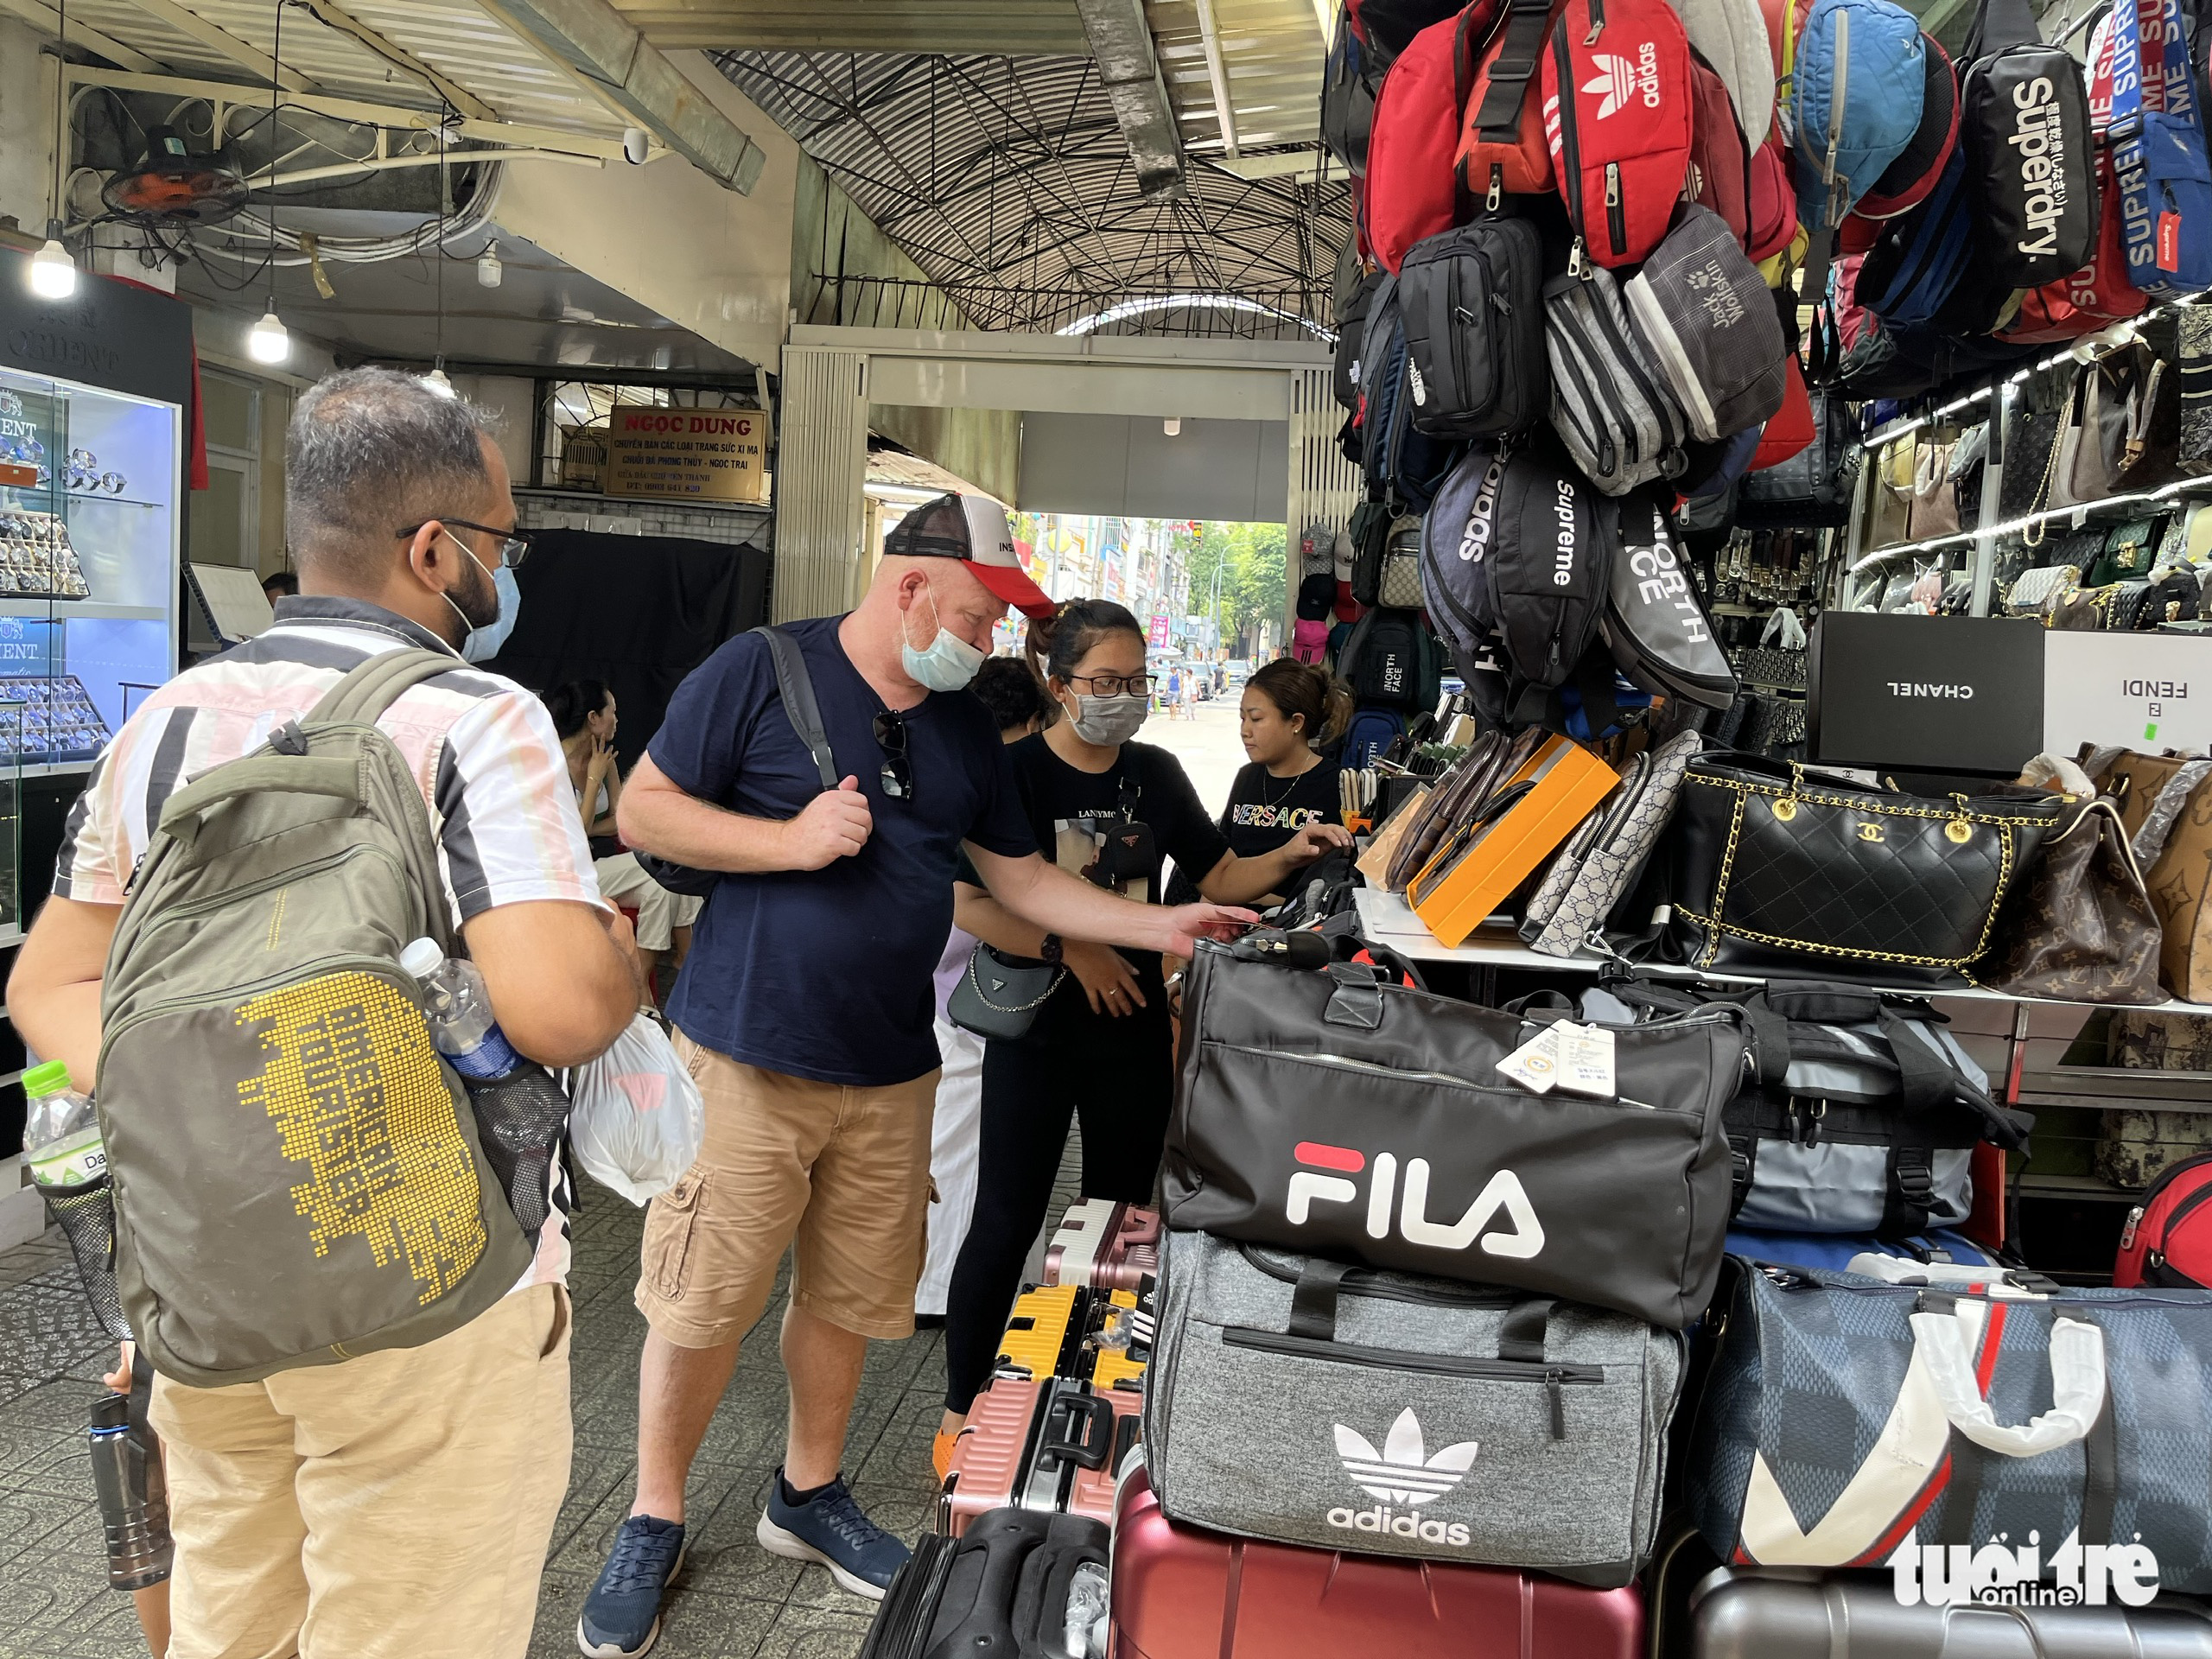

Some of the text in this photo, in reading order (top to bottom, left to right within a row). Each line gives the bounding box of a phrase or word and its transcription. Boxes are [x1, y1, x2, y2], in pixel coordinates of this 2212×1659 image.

[1636, 41, 1660, 108] adidas
[2162, 224, 2172, 262] Supreme
[1706, 259, 1745, 325] Wolfskin
[1703, 292, 1730, 327] Jack
[625, 415, 752, 435] NGỌC DUNG
[660, 440, 675, 450] CÁC
[696, 442, 719, 452] TRANG
[737, 444, 745, 454] XI
[747, 445, 759, 456] MẠ
[709, 459, 728, 469] NGỌC
[731, 460, 748, 469] TRAI
[1554, 480, 1575, 586] Supreme
[1384, 654, 1395, 688] NORTH
[1392, 668, 1402, 692] FACE
[1886, 682, 1974, 699] CHANEL
[2123, 679, 2188, 698] FENDI
[1367, 741, 1378, 768] ORTH
[1232, 804, 1324, 830] VERSACE
[296, 1014, 372, 1217] TOURISTER
[328, 1002, 405, 1195] AMERICAN
[1284, 1141, 1546, 1259] FILA
[1326, 1504, 1471, 1547] adidas
